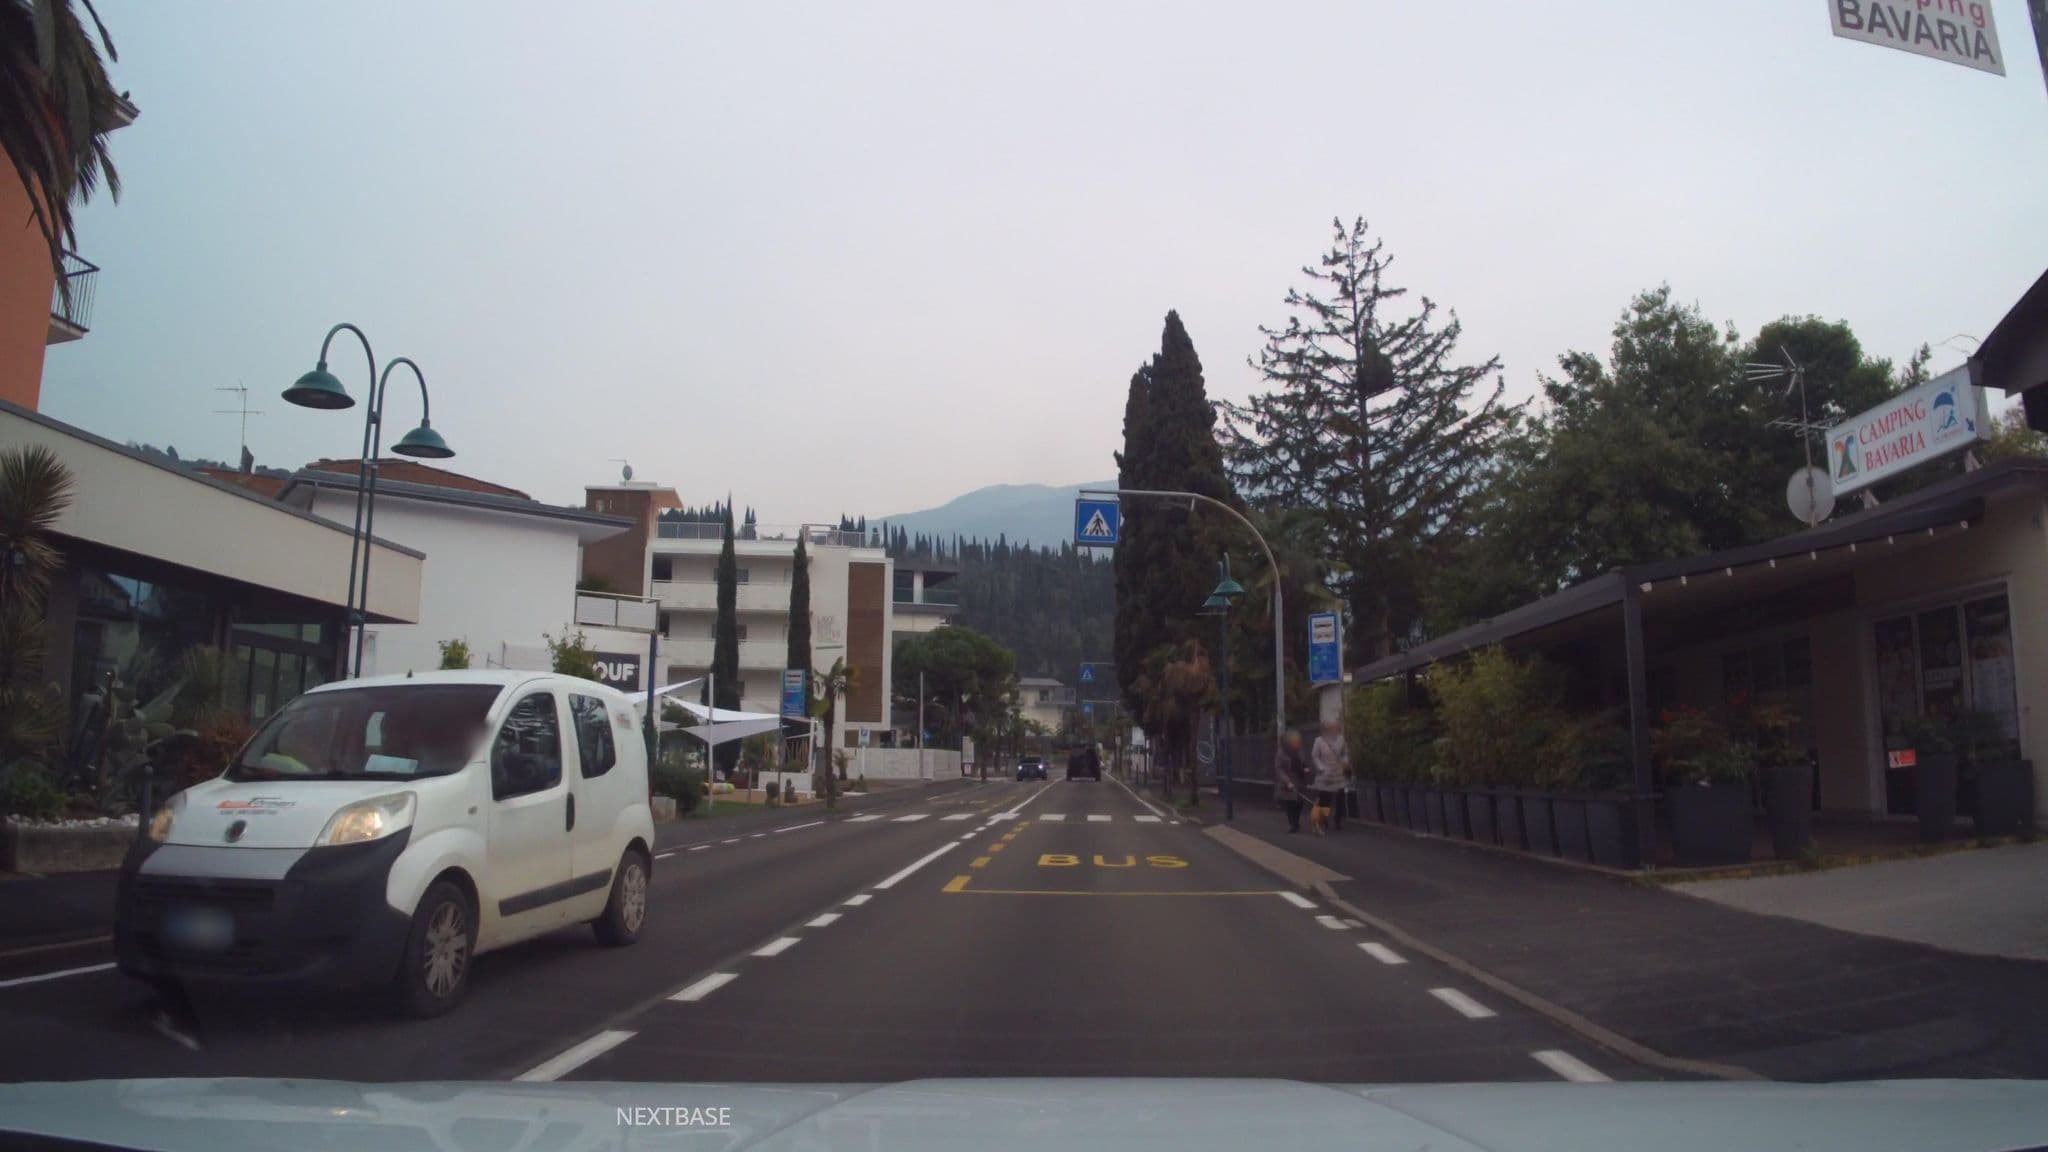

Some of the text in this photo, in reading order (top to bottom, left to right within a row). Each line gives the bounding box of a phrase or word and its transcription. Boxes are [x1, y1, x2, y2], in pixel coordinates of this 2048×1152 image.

[1908, 0, 1986, 28] ping
[1838, 0, 1996, 64] BAVARIA
[1859, 399, 1926, 445] CAMPING
[1865, 431, 1926, 471] BAVARIA
[590, 660, 635, 682] OUF
[1038, 853, 1188, 868] BUS
